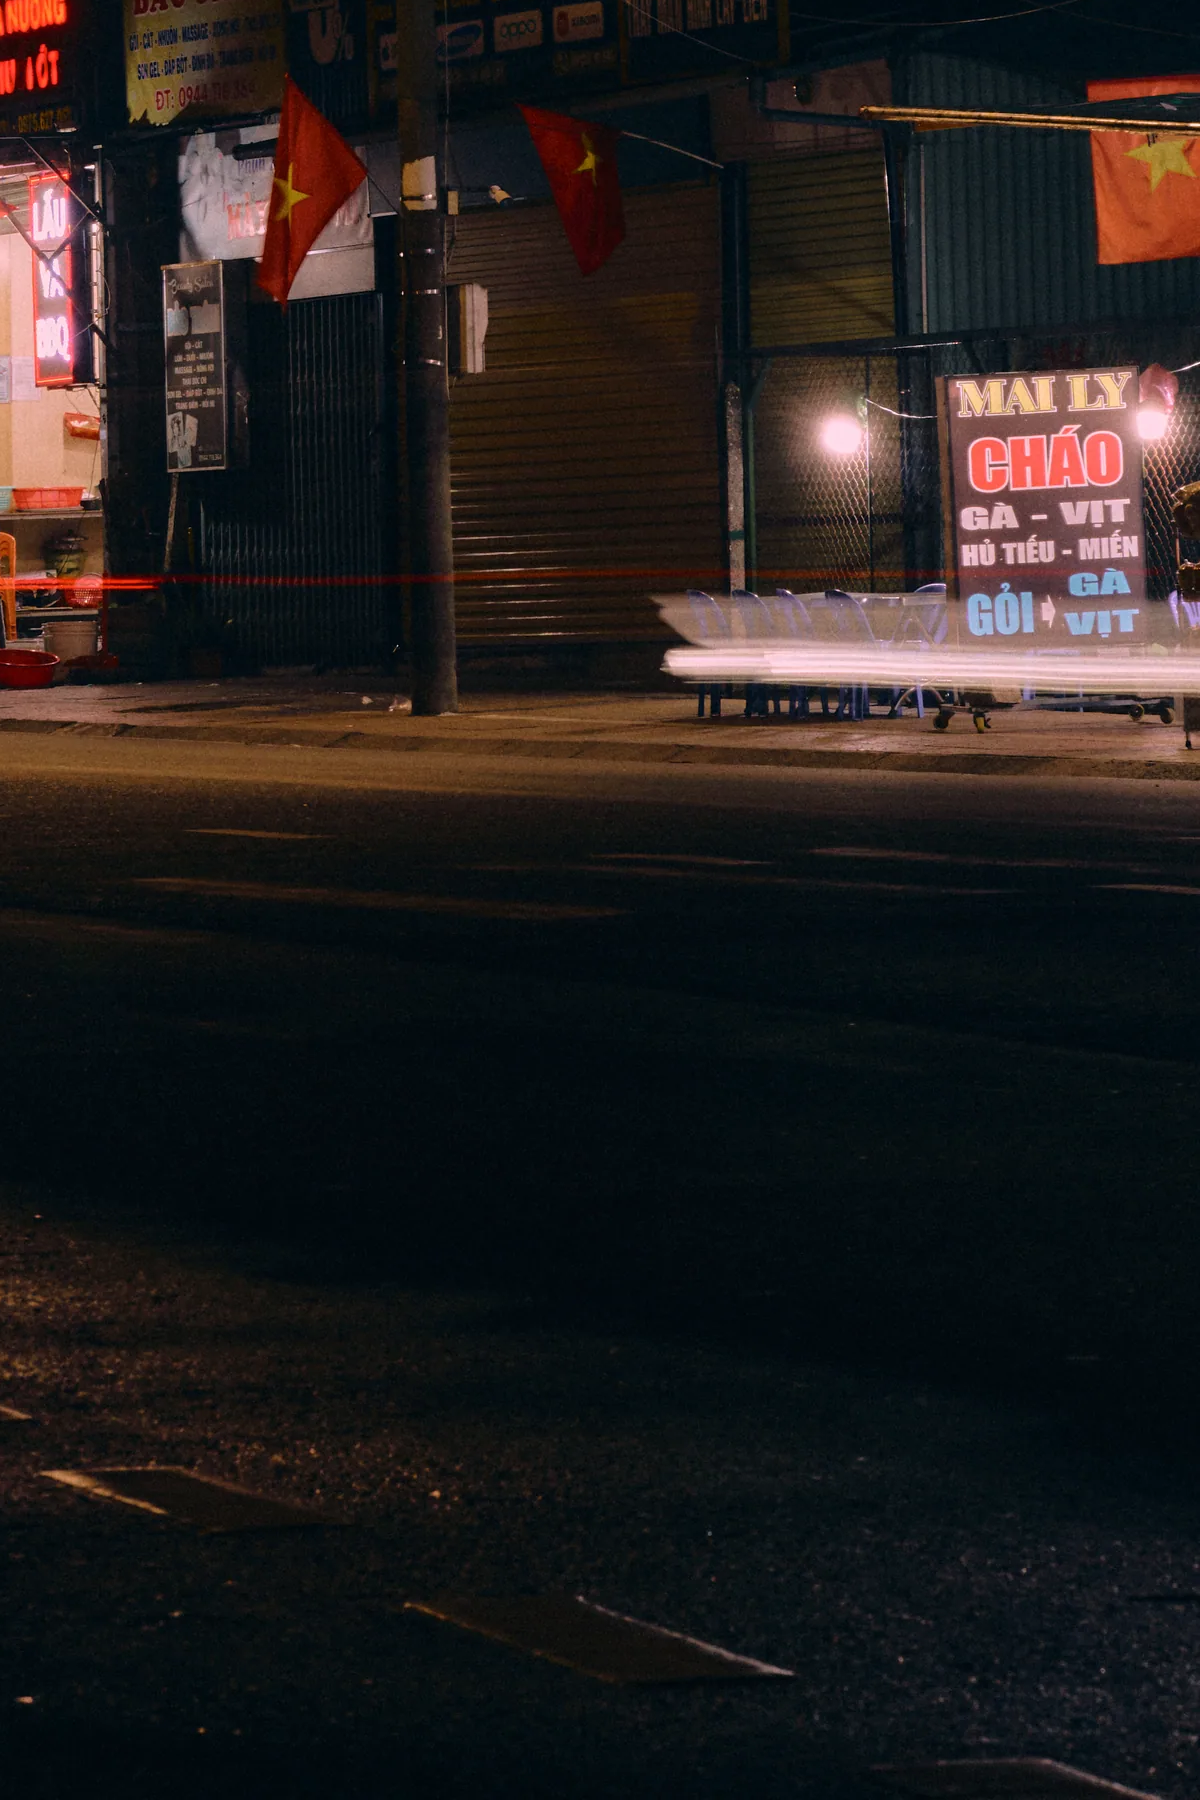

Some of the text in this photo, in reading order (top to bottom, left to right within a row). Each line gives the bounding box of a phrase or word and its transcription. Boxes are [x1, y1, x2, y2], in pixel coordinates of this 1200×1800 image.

[36, 316, 70, 360] BBQ
[956, 372, 1132, 418] MAI LY
[968, 424, 1124, 493] CHÁO
[960, 498, 1130, 530] GÀ VỊT
[961, 530, 1138, 567] HỦ TIẾU MIẾN
[1068, 568, 1132, 596] GÀ
[967, 582, 1034, 636] GỎI
[1064, 608, 1140, 638] VỊT
